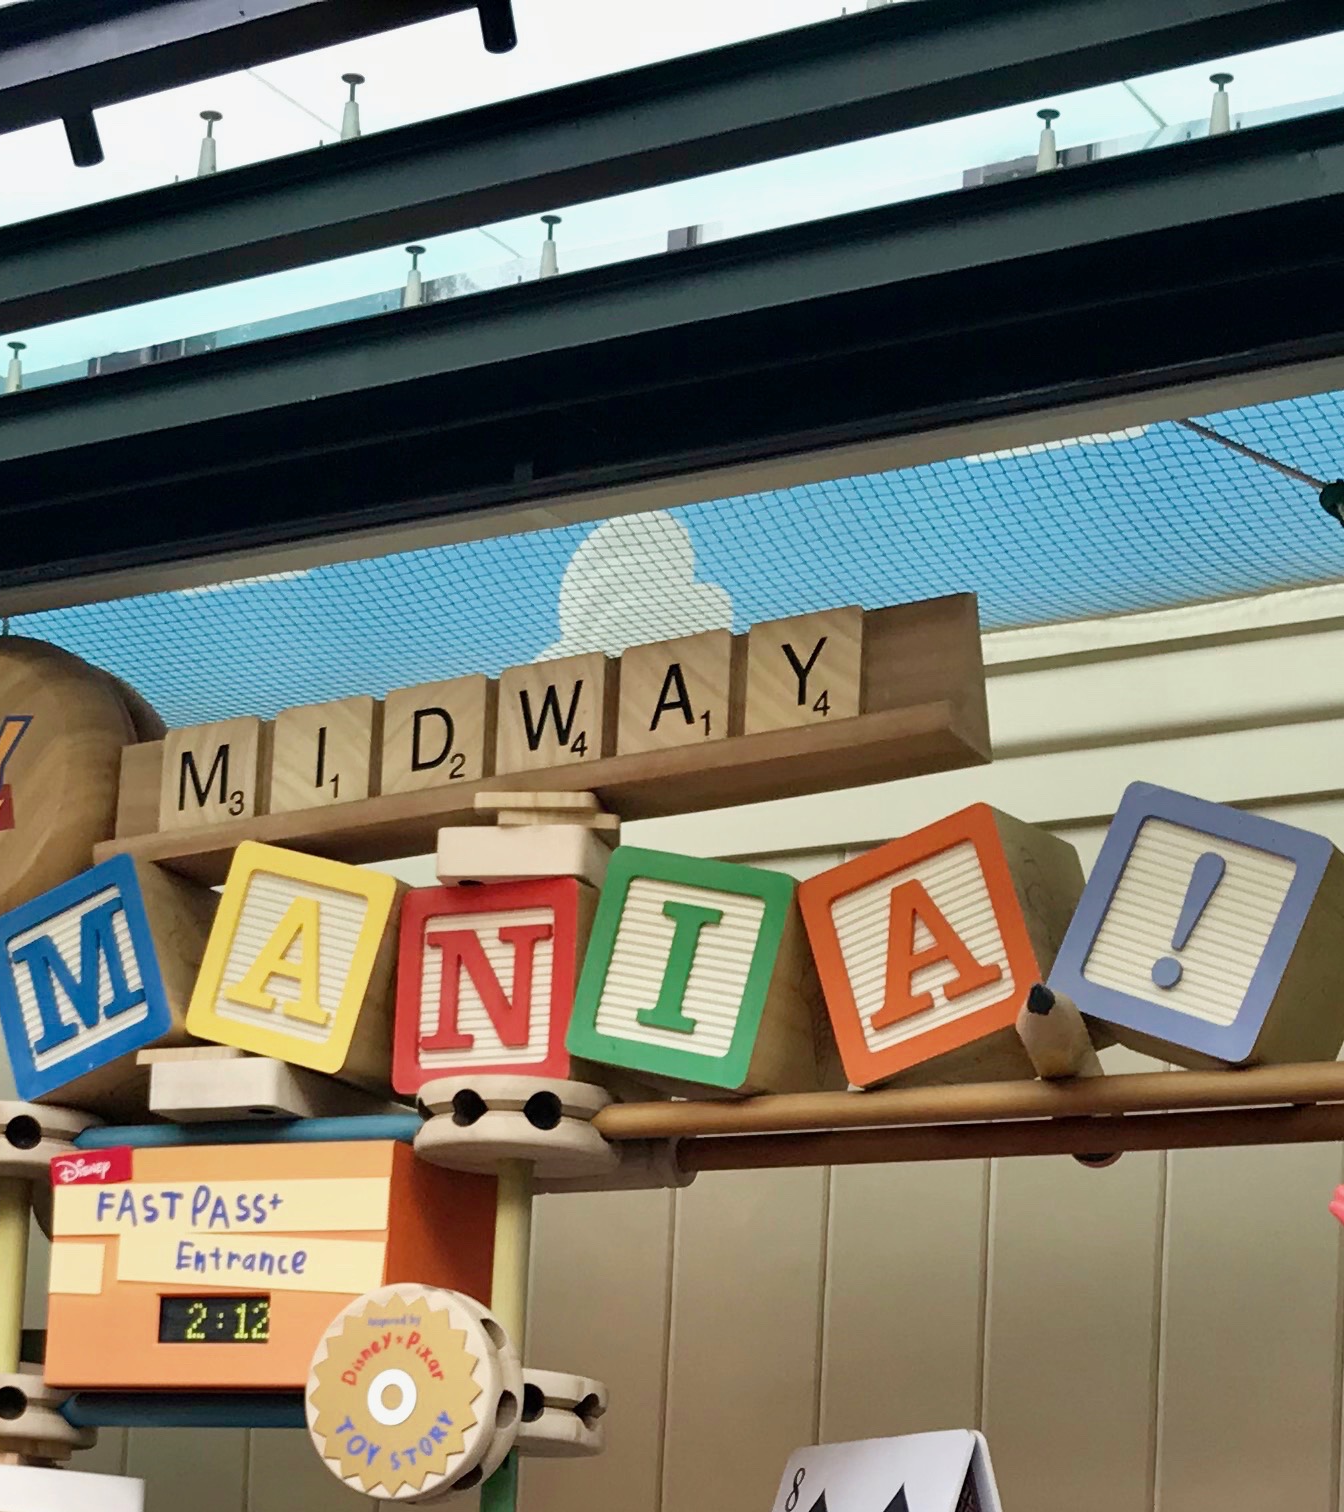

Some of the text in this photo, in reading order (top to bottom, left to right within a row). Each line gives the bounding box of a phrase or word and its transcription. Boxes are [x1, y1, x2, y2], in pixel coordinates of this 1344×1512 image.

[55, 1158, 111, 1183] Disney
[176, 1241, 307, 1276] Entrance
[188, 1302, 270, 1339] 2:12
[340, 1330, 444, 1386] Disney Pixar
[335, 1411, 454, 1471] TOY STORY
[784, 1467, 806, 1512] 8
